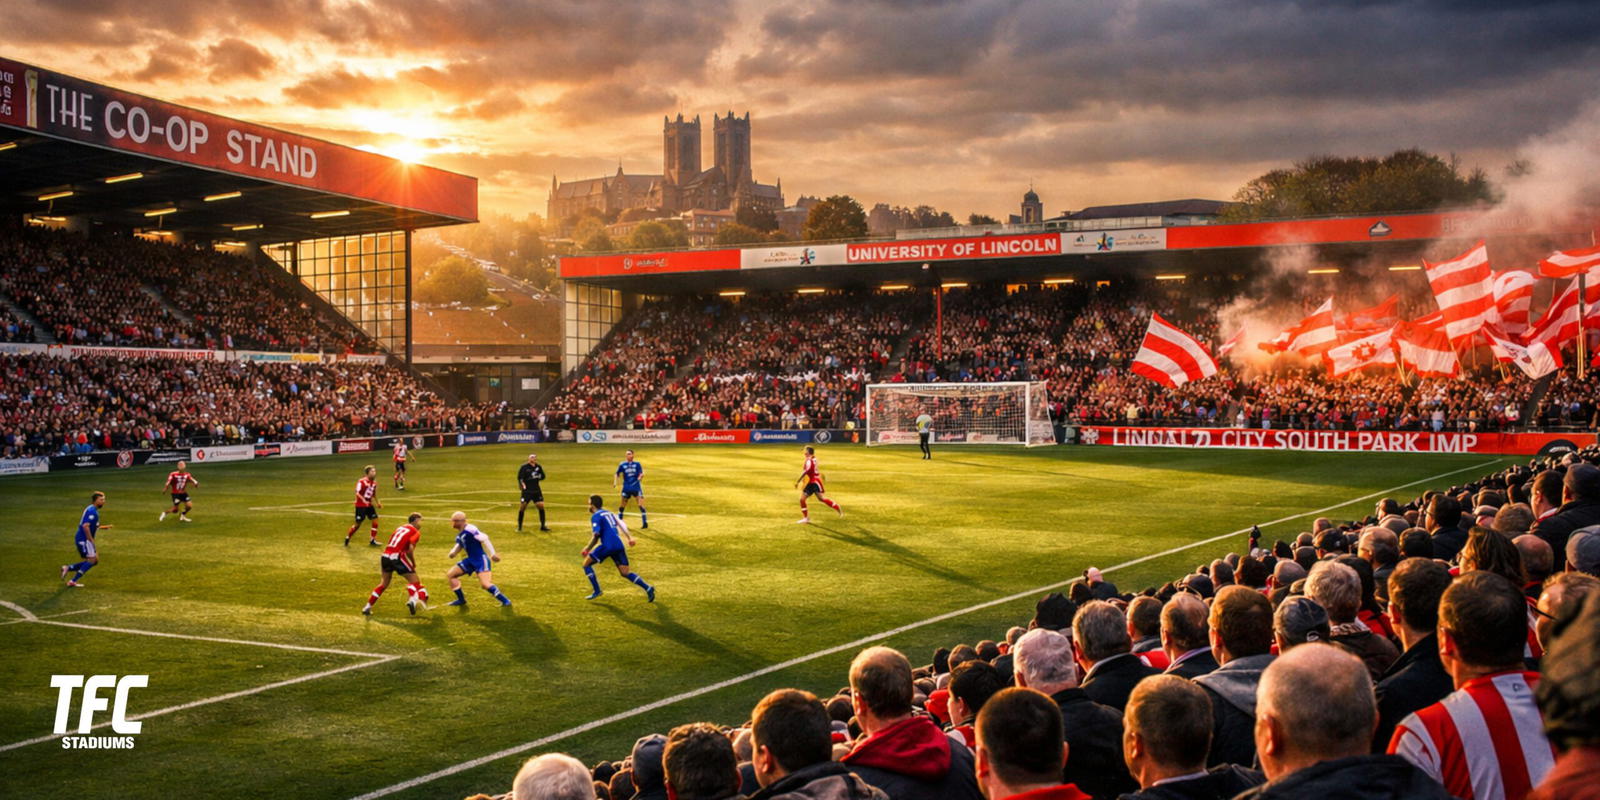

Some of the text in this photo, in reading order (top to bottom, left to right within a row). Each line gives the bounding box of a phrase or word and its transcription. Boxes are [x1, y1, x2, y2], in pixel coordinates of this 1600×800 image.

[46, 83, 93, 132] THE
[104, 100, 209, 154] CO-OP
[227, 130, 317, 178] STAND
[848, 237, 1058, 261] UNIVERSITY OF LINCOLN
[1221, 430, 1267, 449] CITY
[1274, 431, 1349, 451] SOUTH
[1358, 432, 1421, 453] PARK
[1429, 434, 1478, 454] IMP
